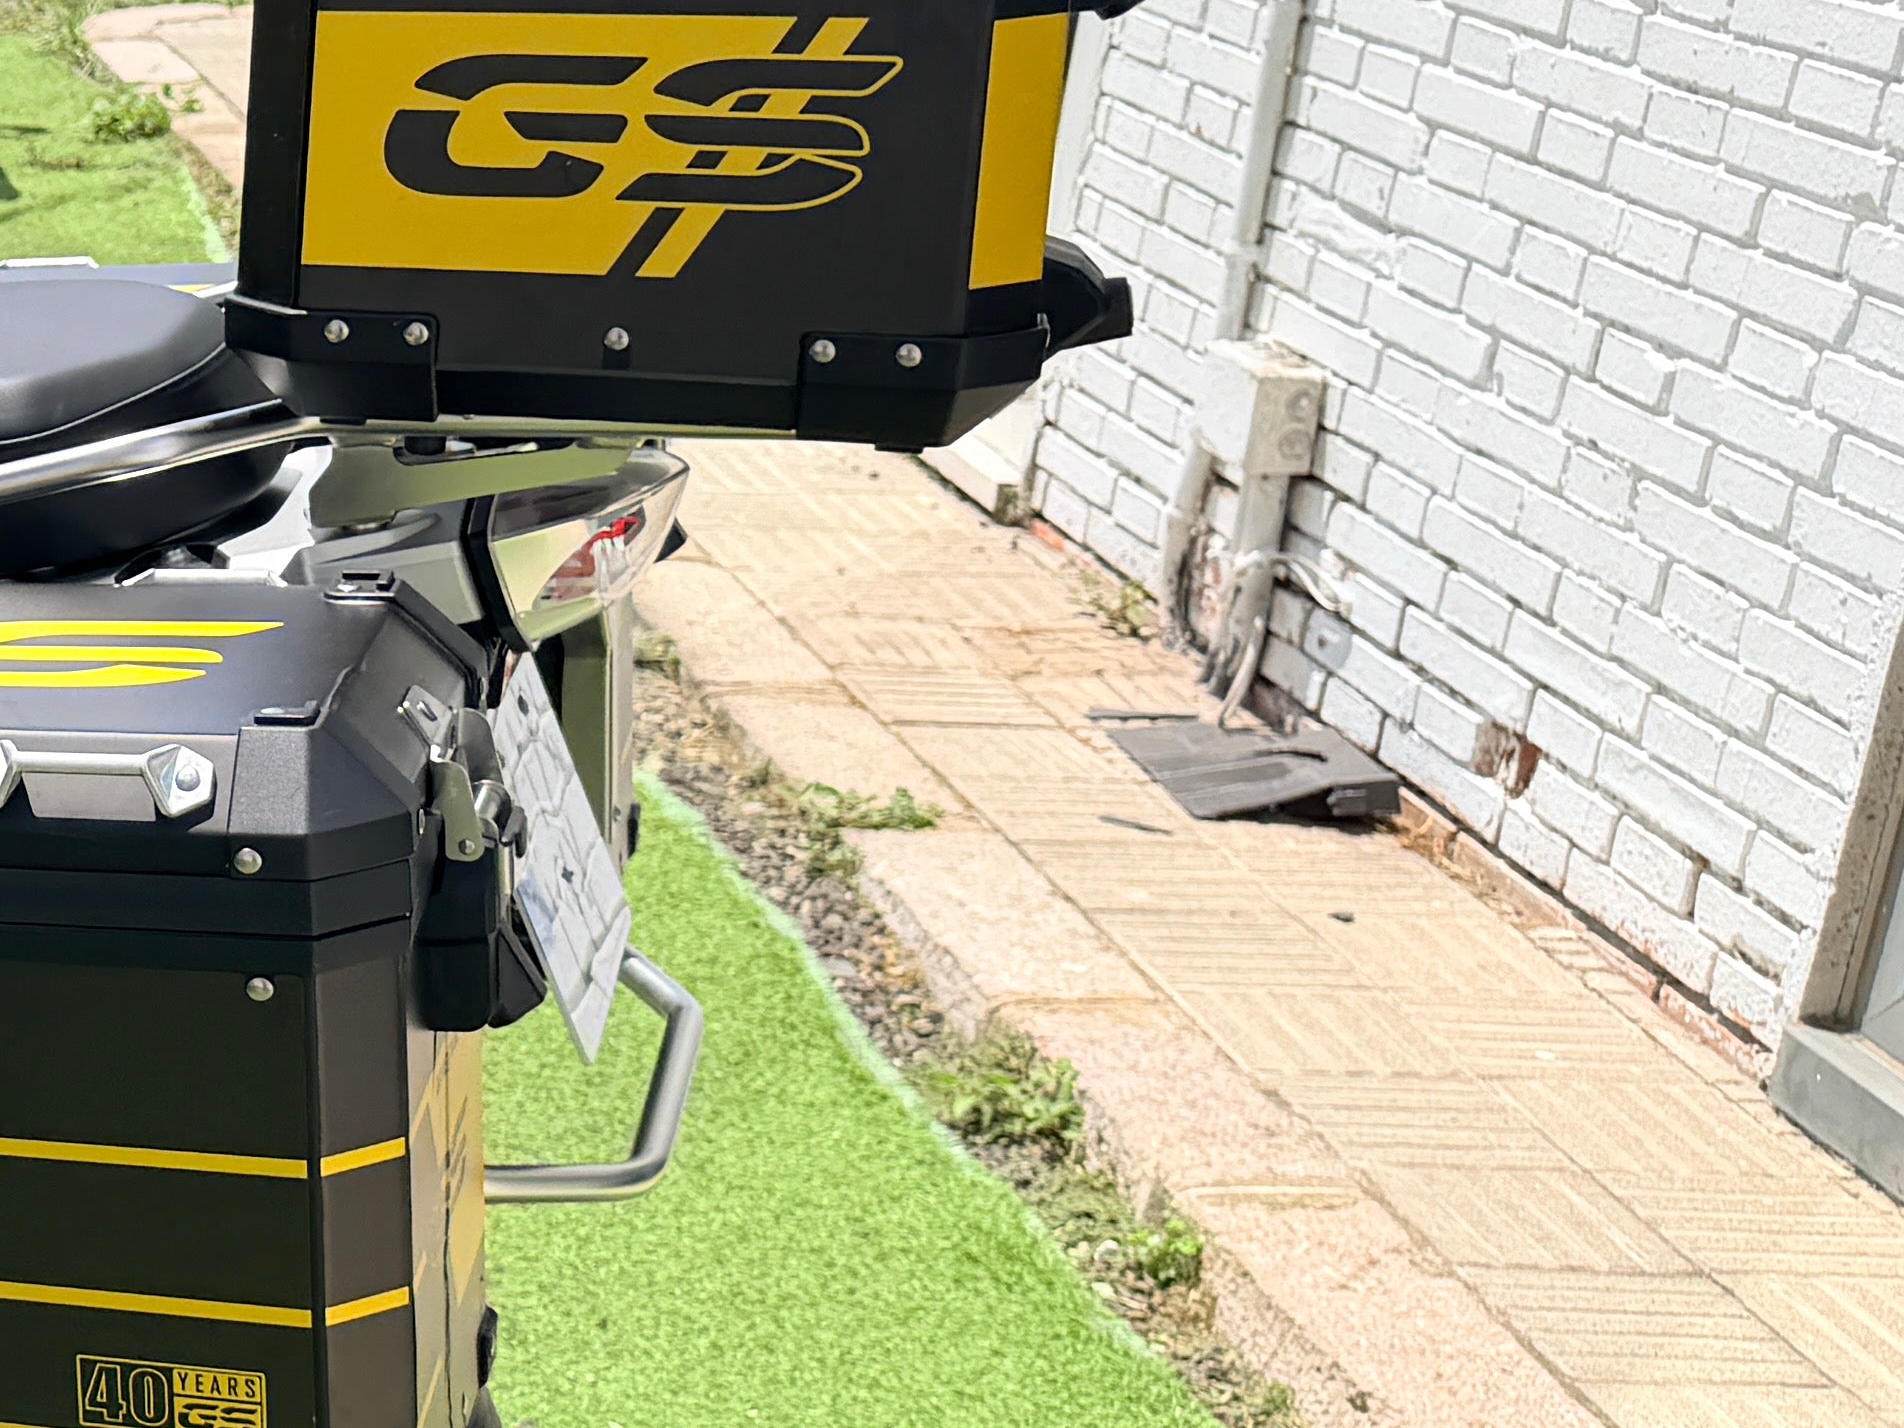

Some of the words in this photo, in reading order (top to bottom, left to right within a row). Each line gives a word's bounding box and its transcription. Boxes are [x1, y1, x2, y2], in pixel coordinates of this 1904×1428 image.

[384, 53, 903, 211] GS
[84, 1362, 169, 1427] 40
[177, 1371, 256, 1399] YEARS
